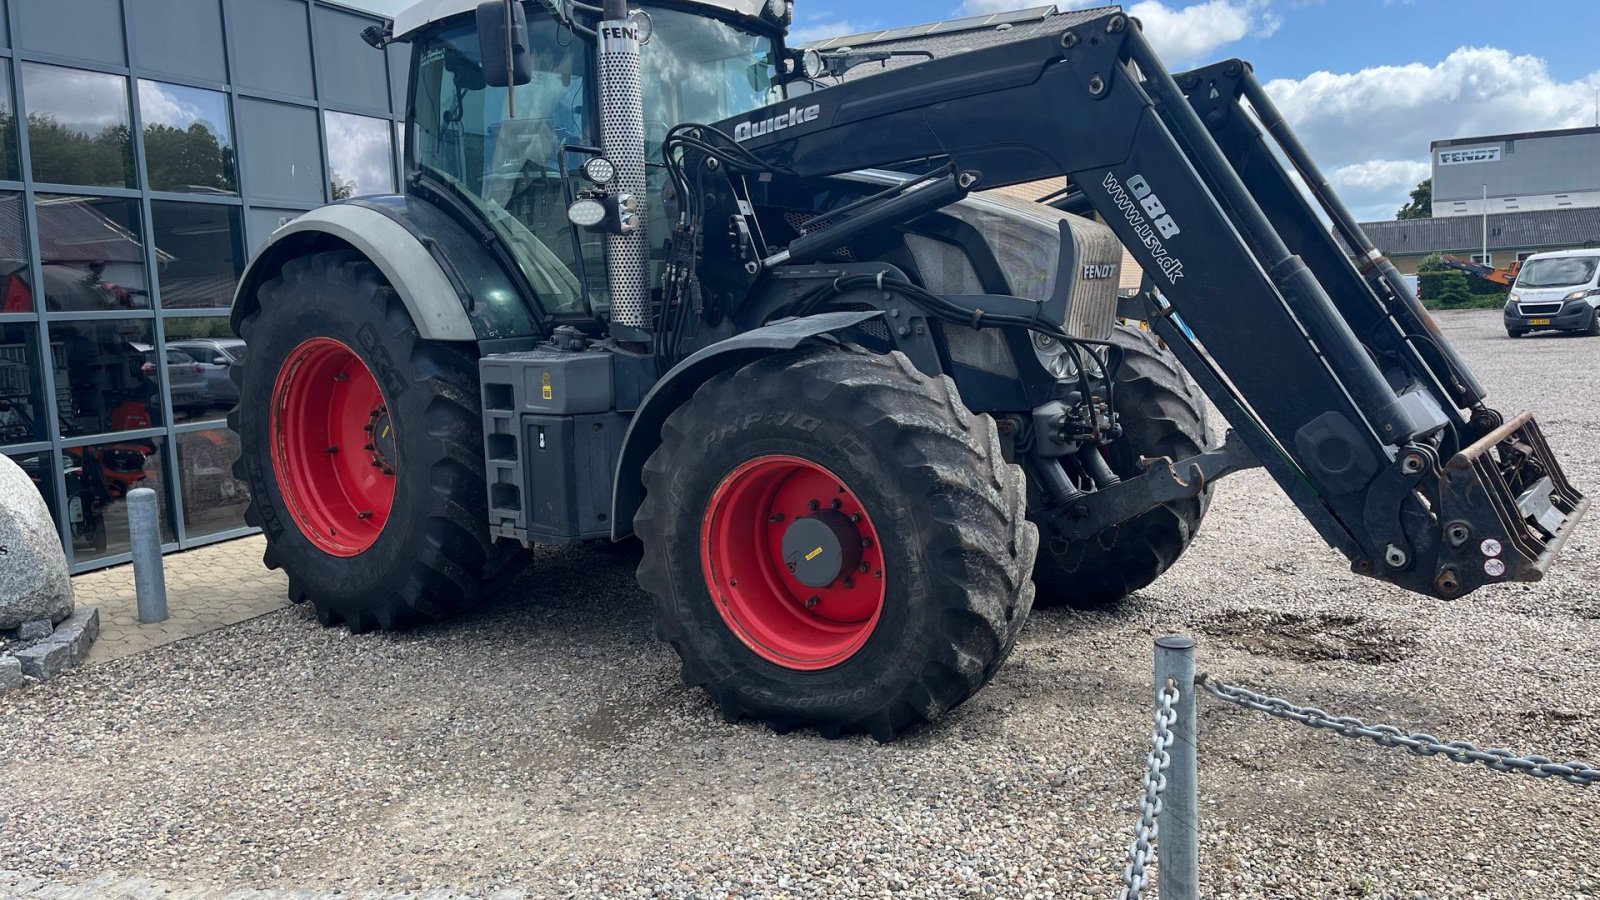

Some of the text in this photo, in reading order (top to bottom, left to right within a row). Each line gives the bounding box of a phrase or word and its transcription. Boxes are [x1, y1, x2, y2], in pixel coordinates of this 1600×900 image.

[734, 104, 820, 143] Quicke
[1440, 149, 1499, 163] FENDT
[1126, 174, 1181, 240] Q88
[1102, 172, 1184, 285] www.usv.dk
[1083, 264, 1117, 279] FENDT
